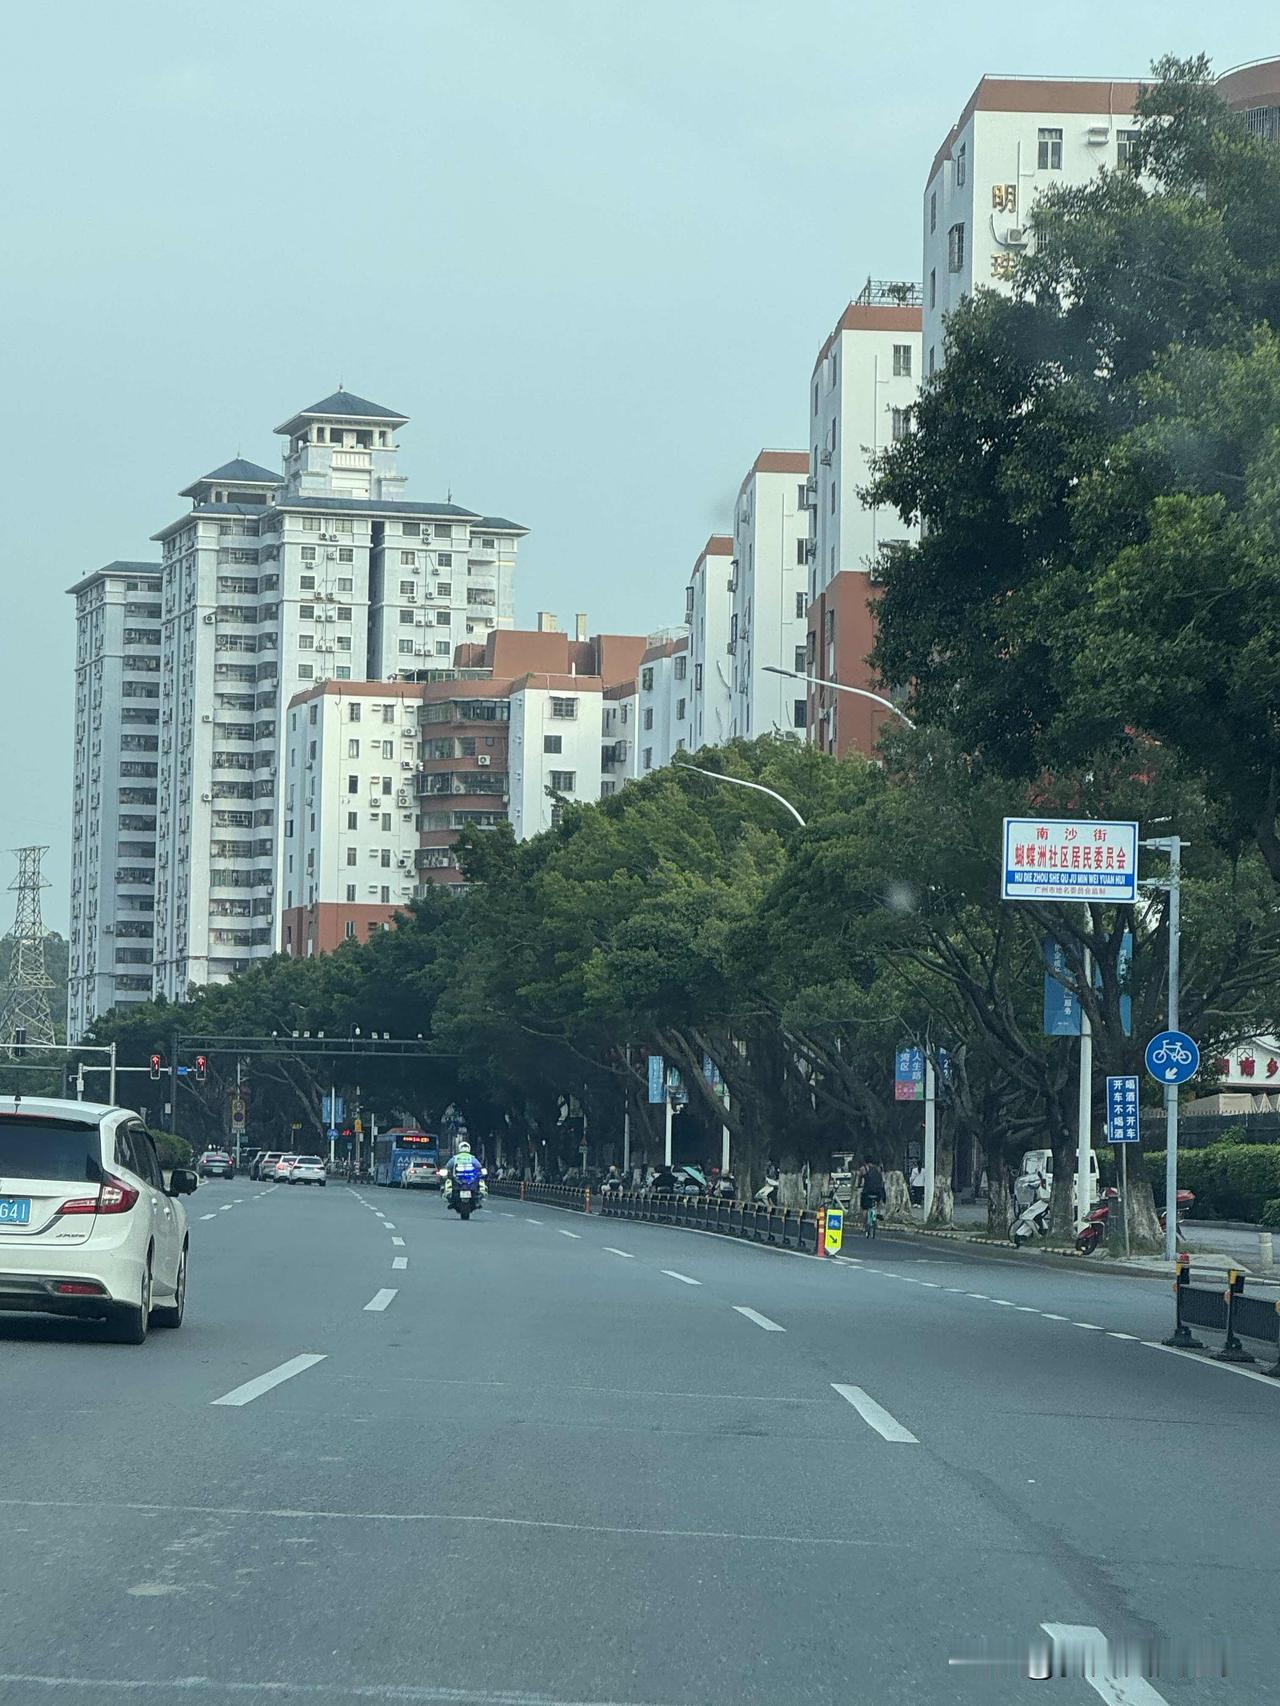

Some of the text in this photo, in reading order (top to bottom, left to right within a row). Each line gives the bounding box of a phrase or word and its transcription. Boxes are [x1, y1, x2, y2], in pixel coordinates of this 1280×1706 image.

[1036, 827, 1107, 842] 南沙街
[1015, 843, 1126, 870] 蝴蝶洲社区居民委员会
[1014, 872, 1023, 882] HU
[1023, 872, 1033, 882] DIE
[1033, 873, 1048, 883] ZHOU
[1049, 873, 1060, 883] SHE
[1069, 873, 1077, 884] JU
[1088, 874, 1099, 884] WEI
[1099, 874, 1115, 885] YUAN
[1115, 875, 1126, 885] HUI
[1113, 1079, 1124, 1139] 开车不喝酒
[1125, 1079, 1136, 1139] 喝酒不开车
